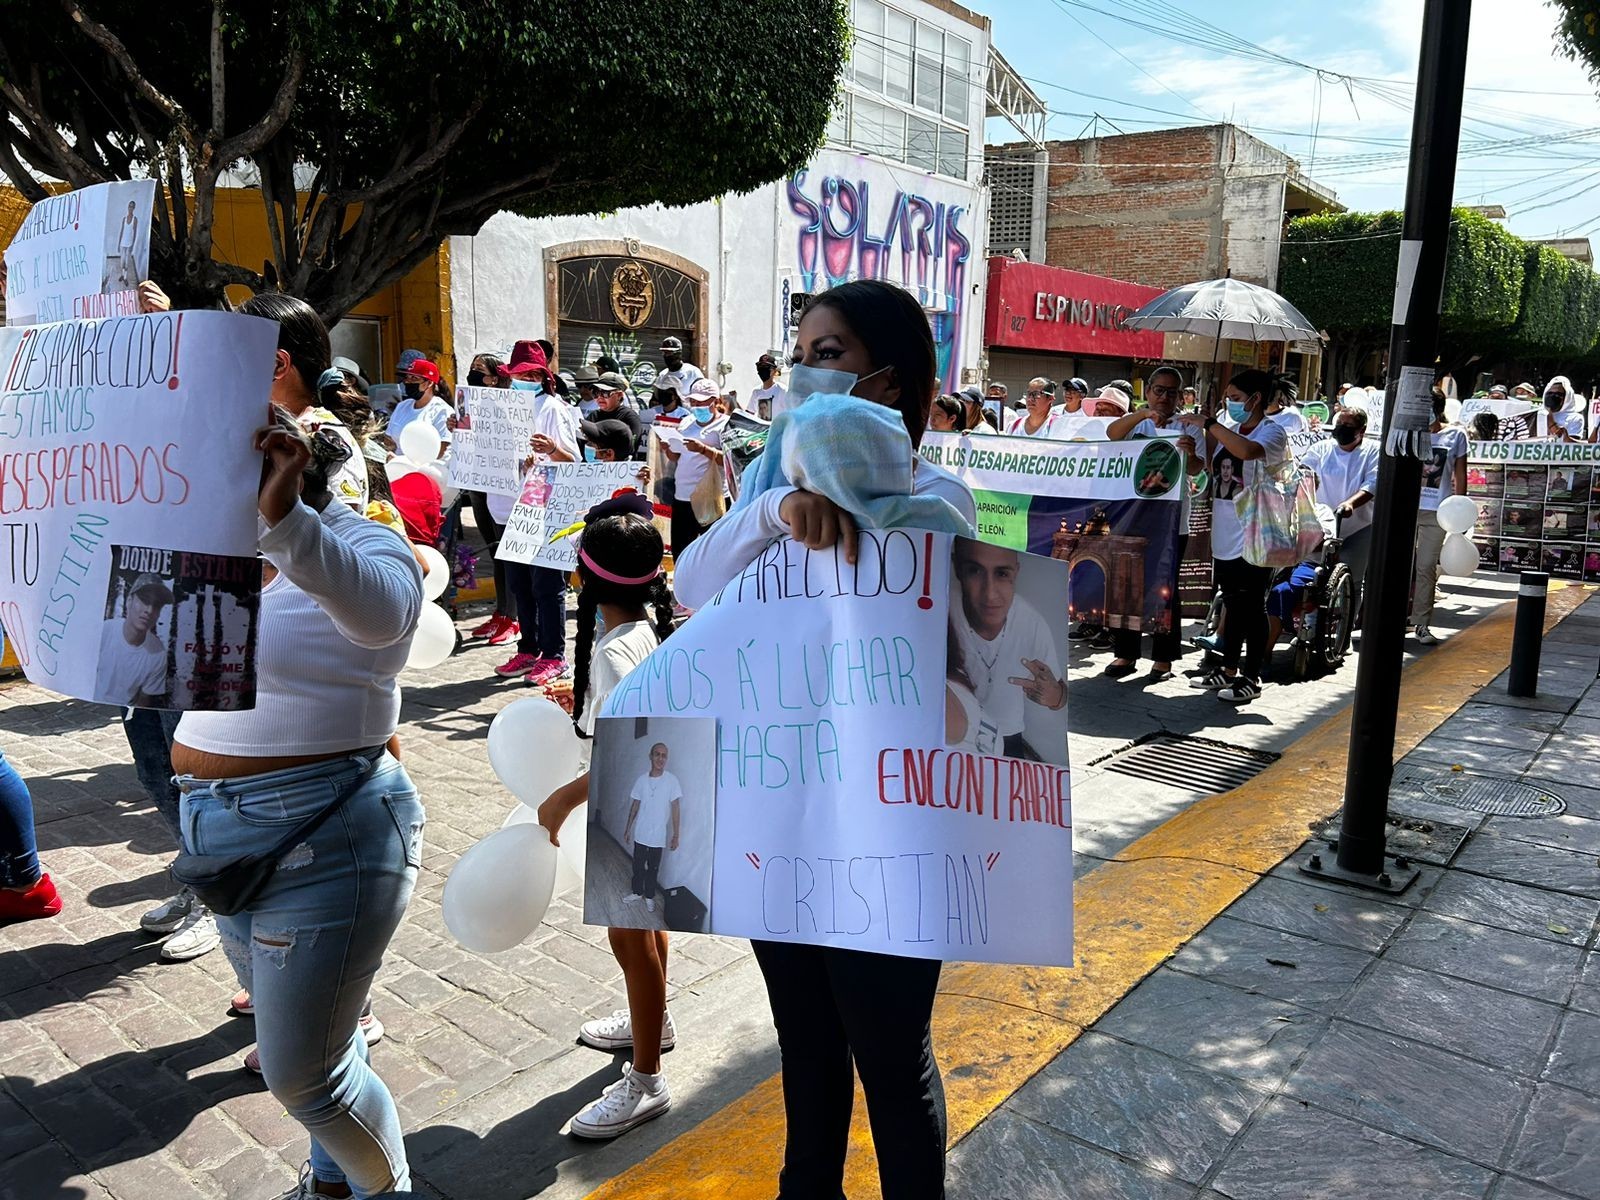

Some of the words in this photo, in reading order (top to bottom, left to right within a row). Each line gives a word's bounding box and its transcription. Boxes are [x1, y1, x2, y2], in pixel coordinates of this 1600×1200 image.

[787, 168, 971, 263] SOLARIS
[47, 244, 90, 284] LUCHAR
[1035, 292, 1094, 327] ESPINO
[1010, 316, 1027, 332] 827
[4, 313, 183, 391] ¡DESAPARECIDO!
[468, 389, 478, 401] NO
[480, 389, 526, 405] ESTAMOS
[469, 404, 491, 418] TODOS
[1481, 442, 1510, 459] LOS
[475, 455, 487, 467] TE
[920, 444, 942, 465] POR
[946, 447, 966, 468] LOS
[968, 449, 1079, 478] DESAPARECIDOS
[1078, 457, 1097, 477] DE
[1098, 452, 1133, 479] LEÓN
[0, 442, 189, 515] ESESPERADOS
[471, 471, 481, 485] TE
[557, 463, 573, 478] NO
[576, 463, 639, 480] ESTAMOS
[553, 483, 583, 499] TODOS
[588, 484, 605, 497] NOS
[976, 502, 1017, 516] APARICIÓN
[555, 512, 568, 524] TE
[984, 522, 1007, 537] LEÓN.
[3, 522, 40, 586] TU
[531, 544, 545, 558] TE
[119, 545, 173, 575] DONDE
[222, 663, 243, 673] ME
[776, 636, 921, 711] LUCHAR
[718, 719, 842, 789] HASTA
[877, 747, 1072, 829] ENCONTRARTE
